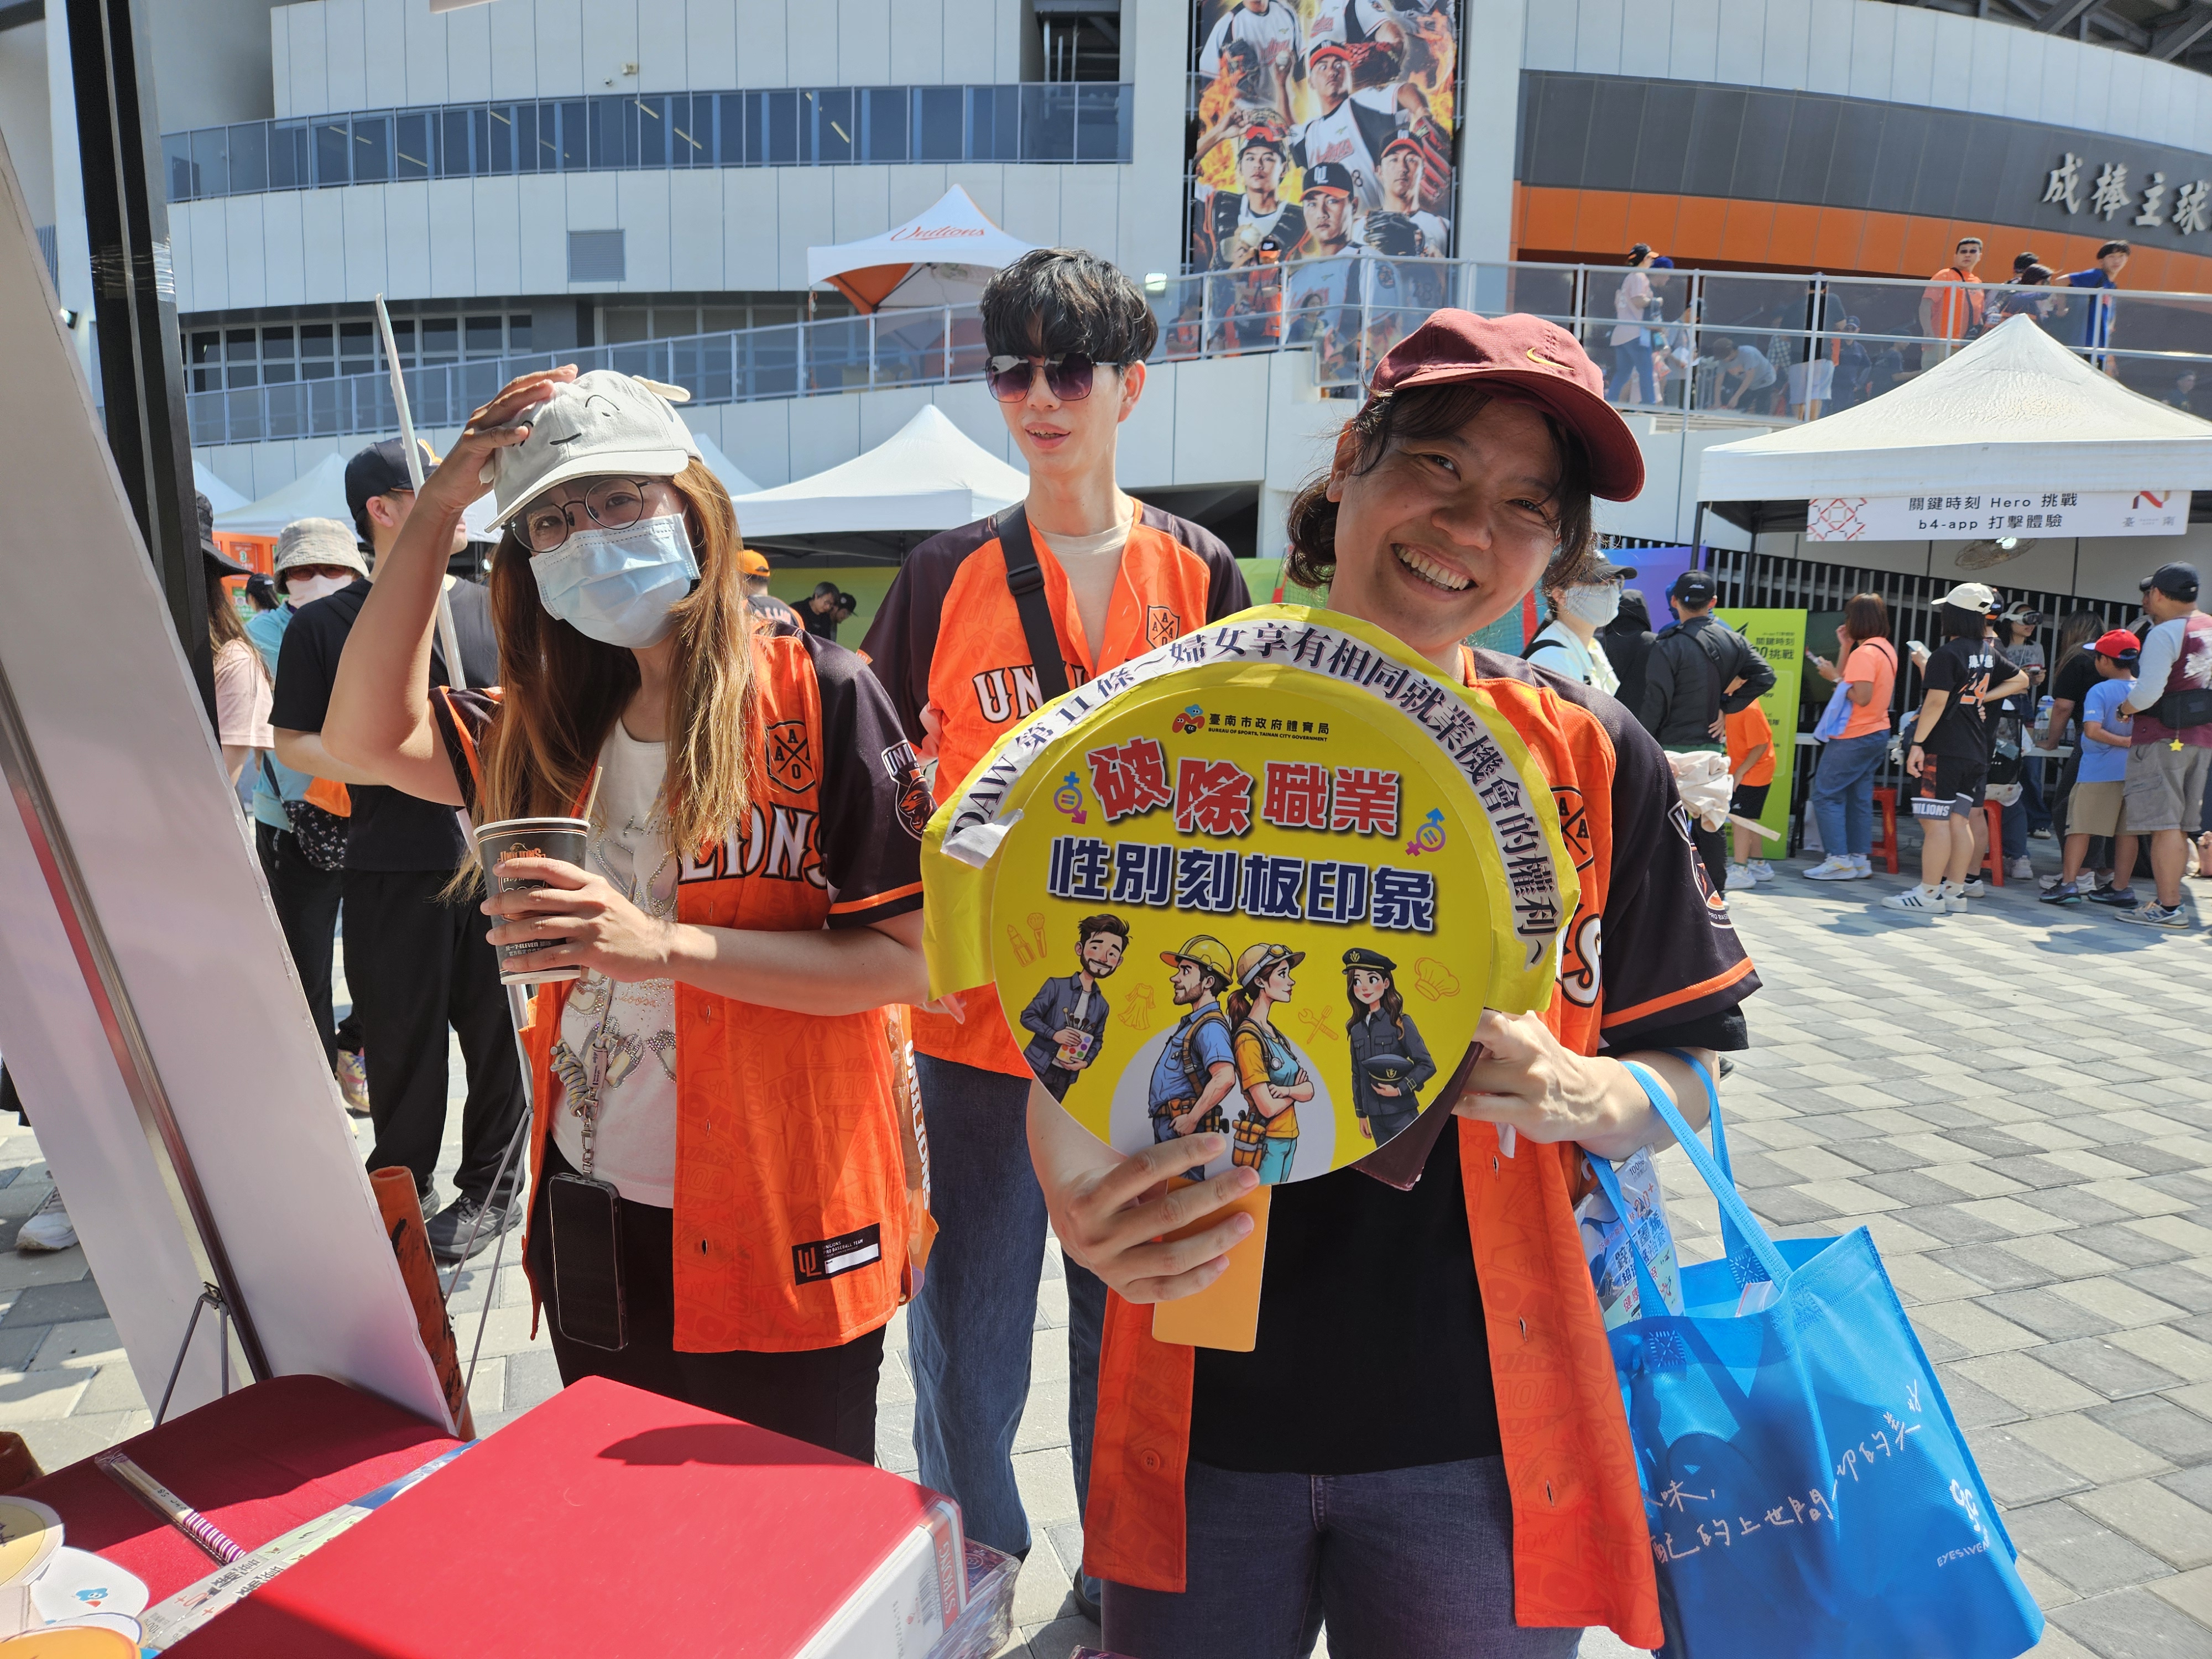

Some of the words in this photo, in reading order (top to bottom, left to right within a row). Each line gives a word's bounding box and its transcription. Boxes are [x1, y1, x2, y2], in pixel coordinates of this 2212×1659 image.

[2042, 152, 2211, 237] 成棒主球
[1908, 495, 1981, 512] 關鍵時刻
[1990, 497, 2032, 508] Hero
[2041, 493, 2078, 508] 挑戰
[1918, 518, 1978, 532] b4-app
[1988, 514, 2063, 530] 打擊體驗
[1208, 713, 1329, 735] 臺南市政府體育局
[1086, 737, 1399, 835] 破除職業
[1911, 803, 1950, 817] NILIONS
[1050, 835, 1434, 931] 性別刻板印象
[1629, 1160, 1646, 1176] 100%
[832, 1243, 853, 1253] BASEBALL
[937, 1540, 957, 1615] STRONG
